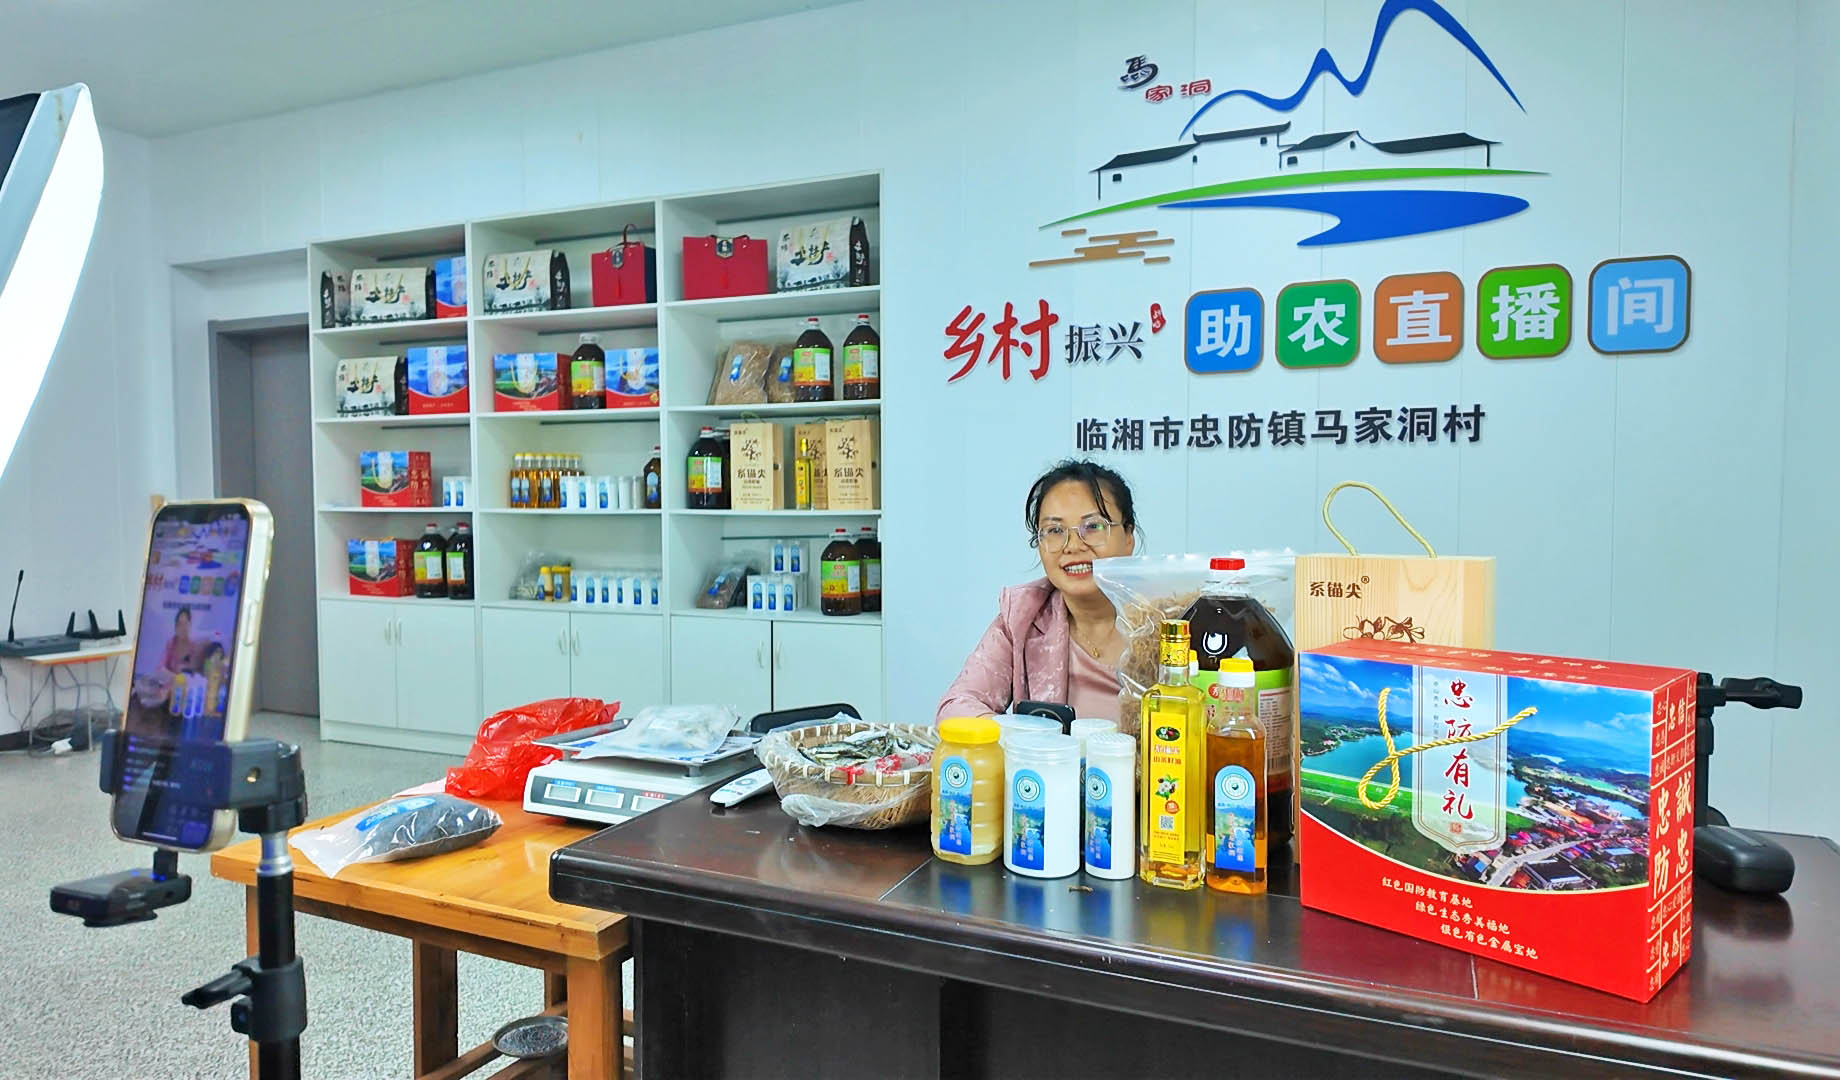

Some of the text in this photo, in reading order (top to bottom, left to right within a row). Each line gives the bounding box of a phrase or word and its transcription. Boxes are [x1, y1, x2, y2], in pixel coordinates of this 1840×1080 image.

[944, 299, 1145, 382] 乡村 振兴
[1195, 277, 1675, 358] 助农直播间
[1077, 404, 1486, 452] 临湘市忠防镇马家洞村
[1442, 679, 1474, 820] 忠防有礼
[1382, 877, 1473, 909] 红色国防教育基地
[1415, 901, 1511, 935] 绿色生态秀美福地
[1440, 923, 1539, 960] 银色有色金属宝地
